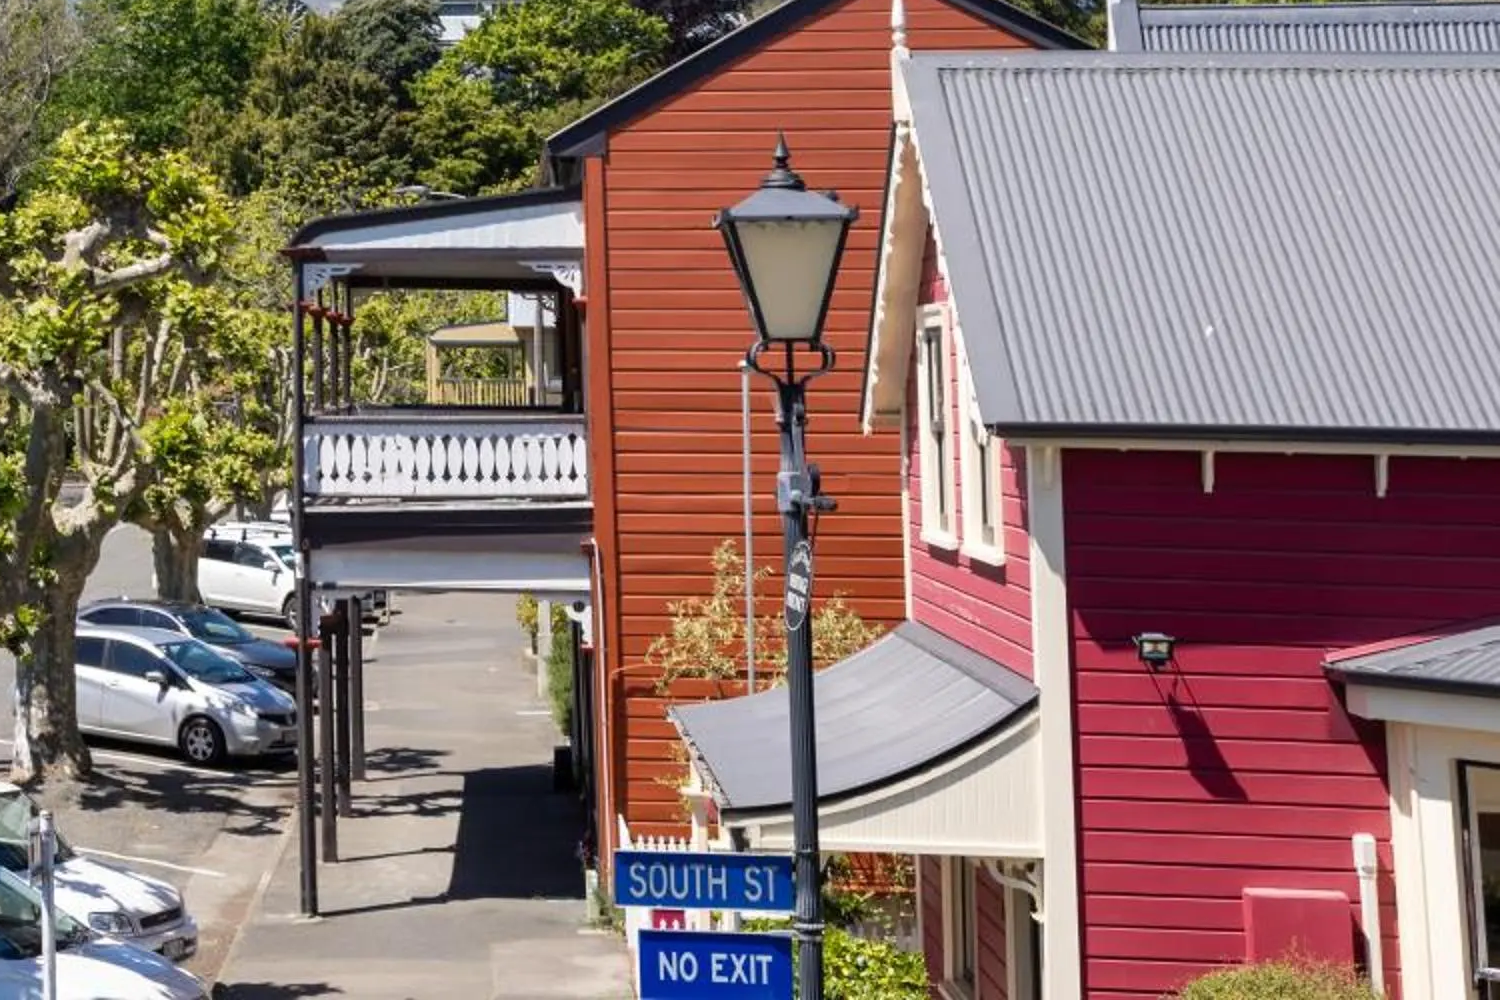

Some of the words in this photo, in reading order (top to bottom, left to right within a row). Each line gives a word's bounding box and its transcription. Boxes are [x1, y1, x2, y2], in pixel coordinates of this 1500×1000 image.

[630, 862, 727, 900] SOUTH
[744, 866, 779, 902] ST
[658, 951, 698, 982] NO
[711, 953, 773, 985] EXIT
